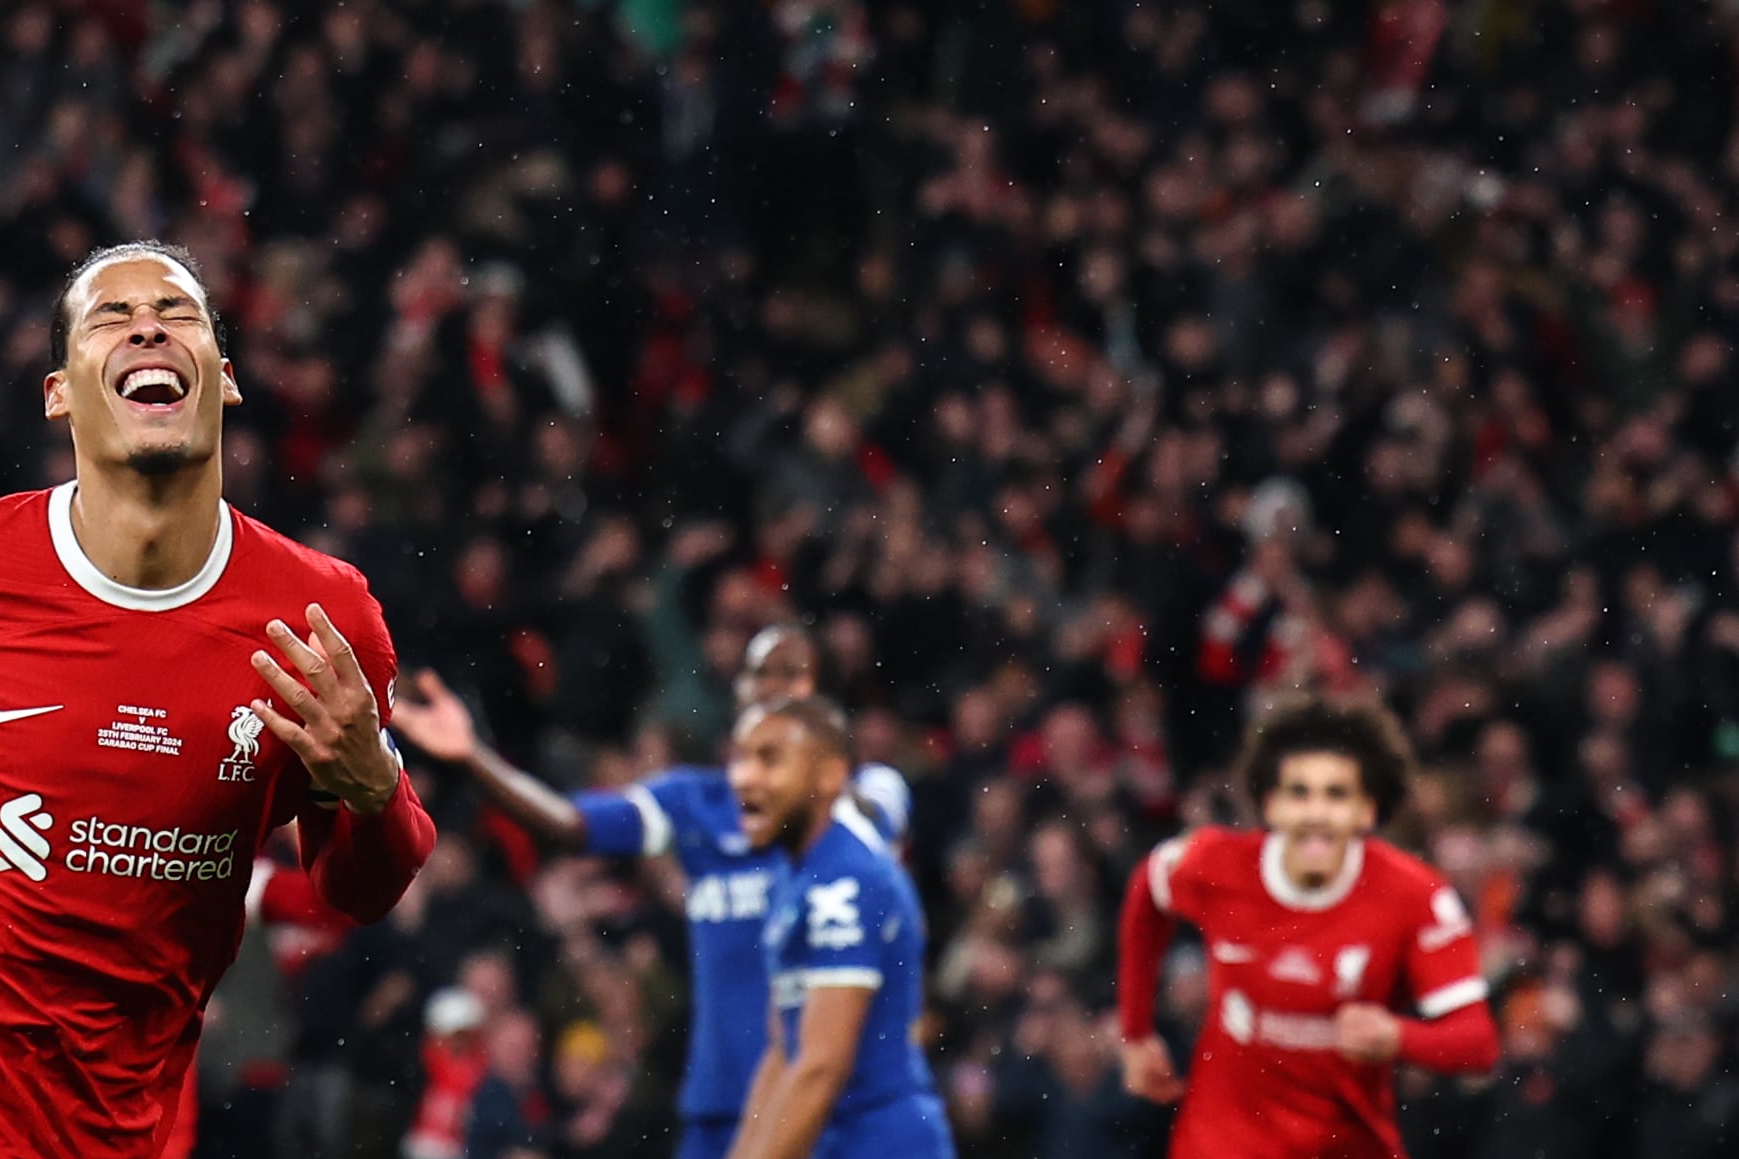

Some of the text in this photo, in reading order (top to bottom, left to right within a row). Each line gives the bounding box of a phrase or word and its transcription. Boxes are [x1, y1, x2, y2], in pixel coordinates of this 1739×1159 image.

[117, 704, 167, 718] CHELSEA FC
[98, 728, 182, 747] 25TH FEBRUARY 2024
[112, 721, 168, 736] LIVERPOOL FC
[98, 738, 180, 756] CARABAO CUP FINAL
[68, 816, 239, 855] standard
[65, 845, 235, 882] chartered
